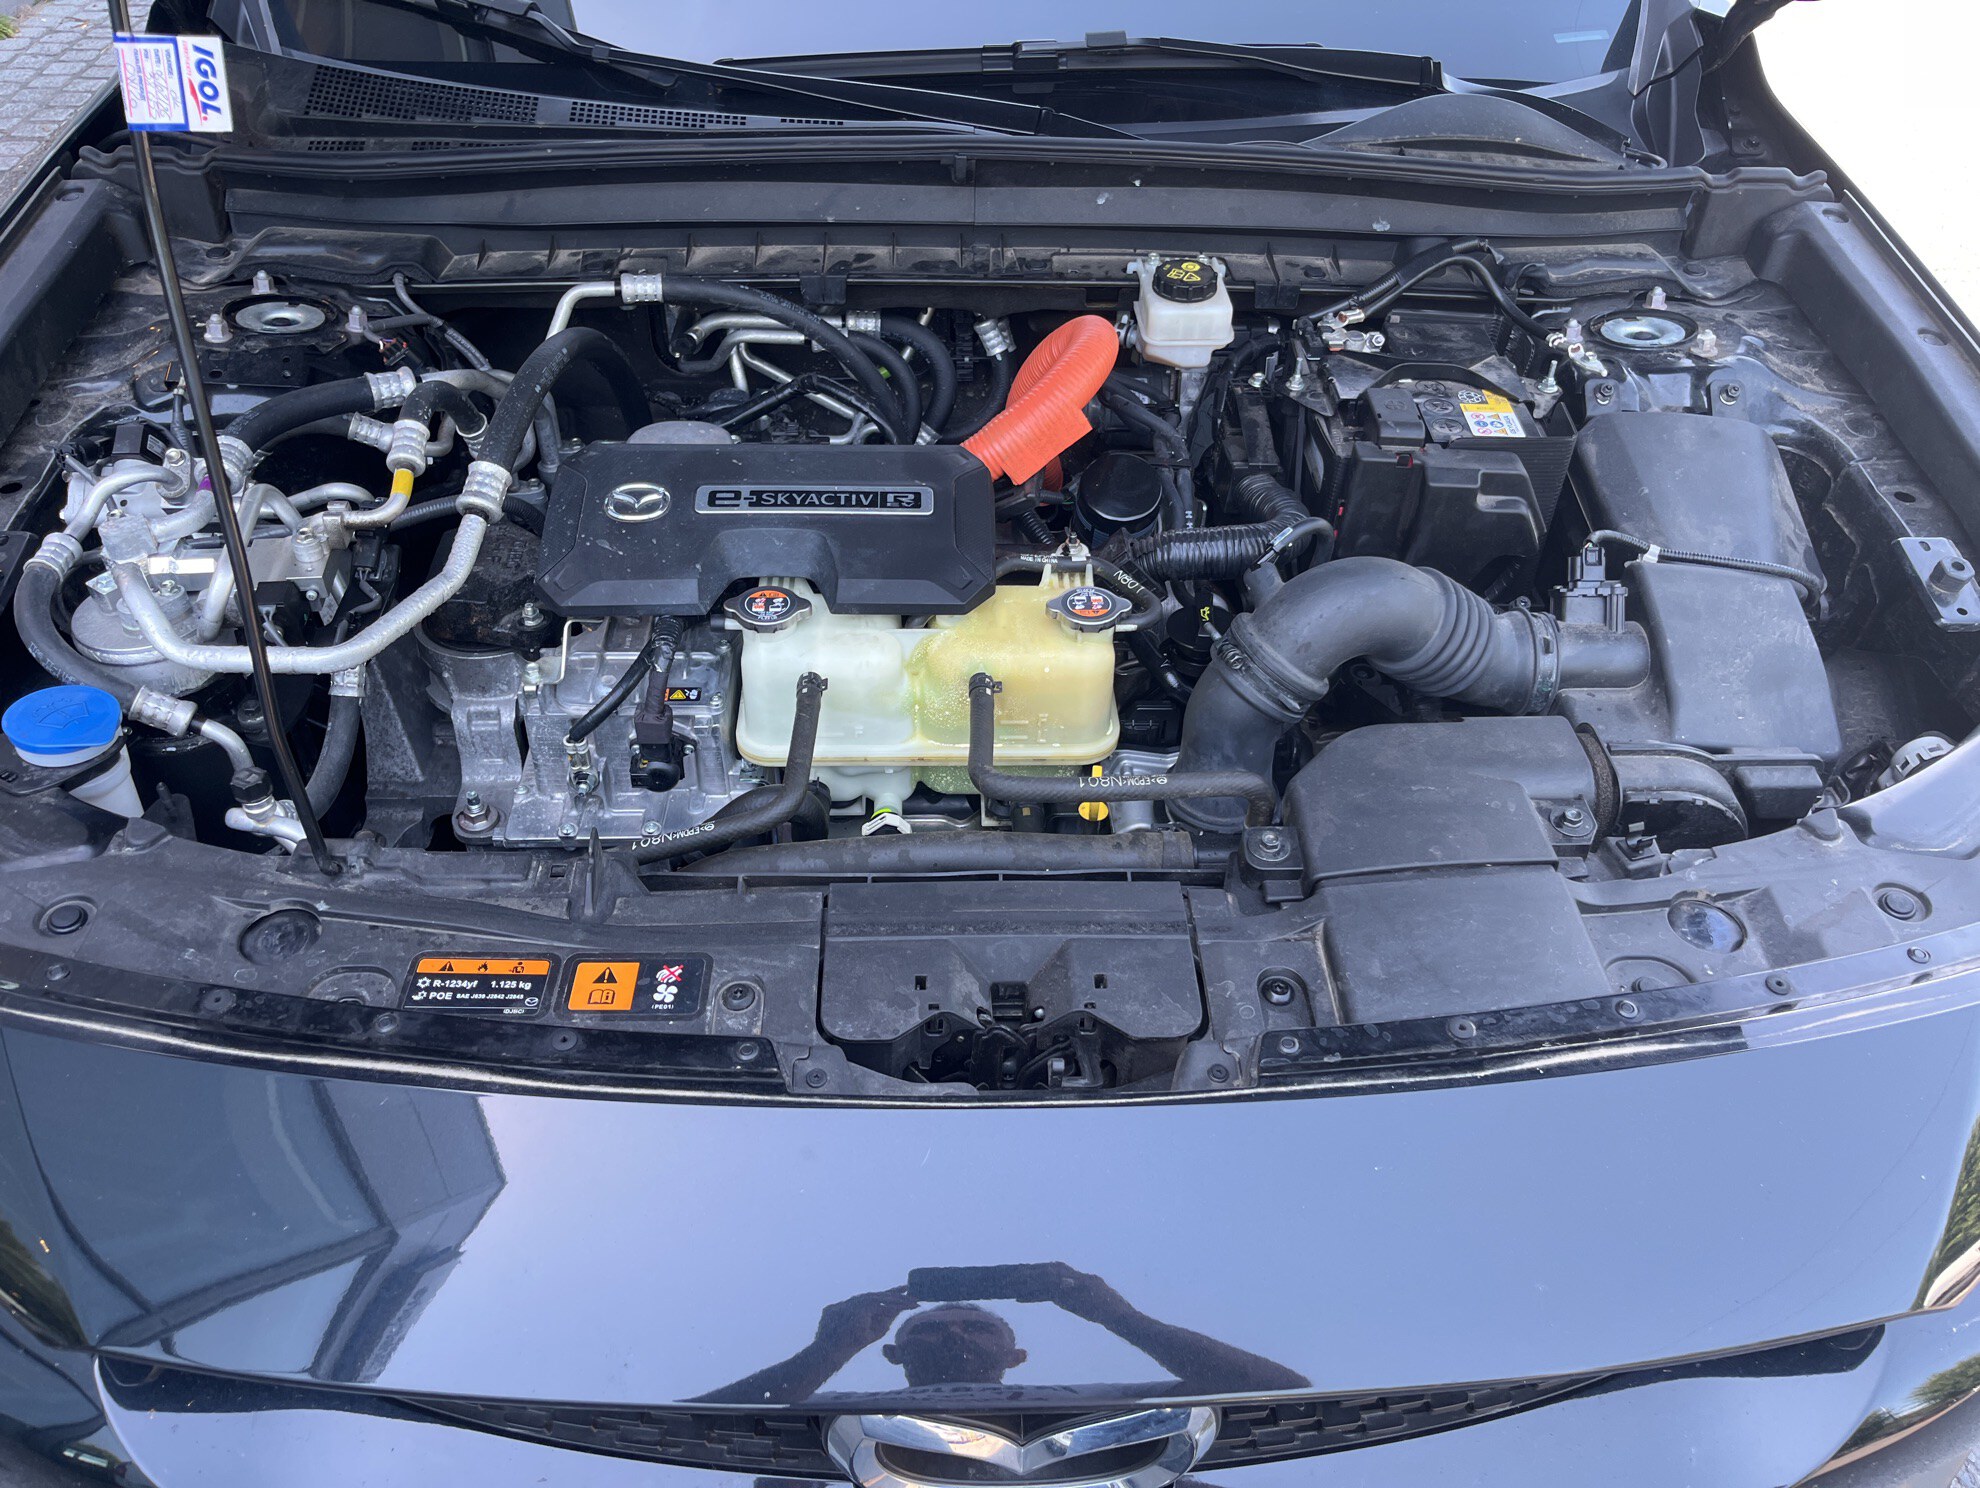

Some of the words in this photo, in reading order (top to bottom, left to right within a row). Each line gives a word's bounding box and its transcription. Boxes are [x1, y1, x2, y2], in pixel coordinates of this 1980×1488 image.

[1113, 570, 1145, 594] N801
[432, 979, 478, 990] R-1234yf
[490, 980, 517, 988] 1.125
[518, 980, 532, 990] kg
[428, 992, 453, 1000] POE
